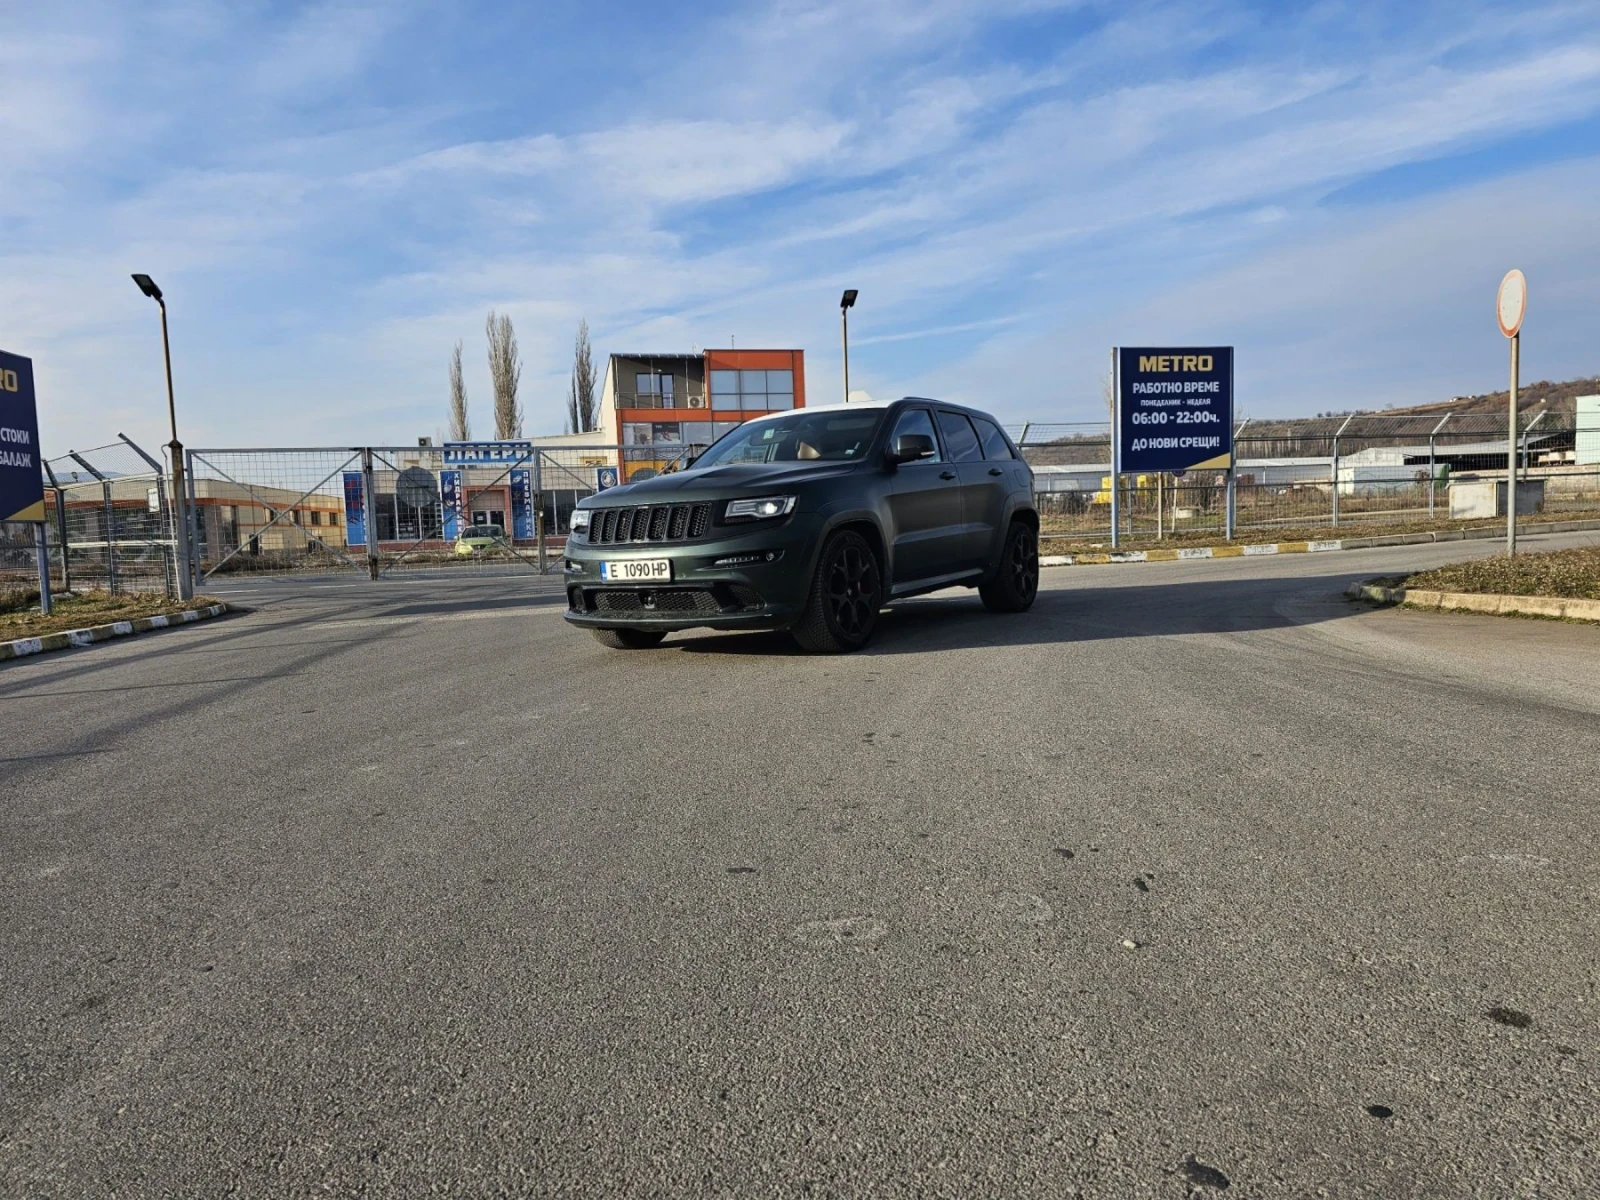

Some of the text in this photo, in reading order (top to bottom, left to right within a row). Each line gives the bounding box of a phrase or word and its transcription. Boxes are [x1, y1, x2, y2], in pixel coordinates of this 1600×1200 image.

[1139, 355, 1213, 372] METRO
[1132, 381, 1220, 394] РАБОТНО ВРЕМЕ
[1140, 399, 1182, 407] ПОНЕДЕЛНИК
[1186, 398, 1211, 406] НЕДЕЛЯ
[1132, 412, 1168, 425] 06:00
[0, 426, 30, 445] СТОКИ
[448, 444, 528, 460] ЛАГЕРИ
[1131, 436, 1220, 452] ДО НОВИ СРЕЩИ!
[523, 471, 532, 537] ПНЕВМАТИКА
[610, 564, 618, 577] E
